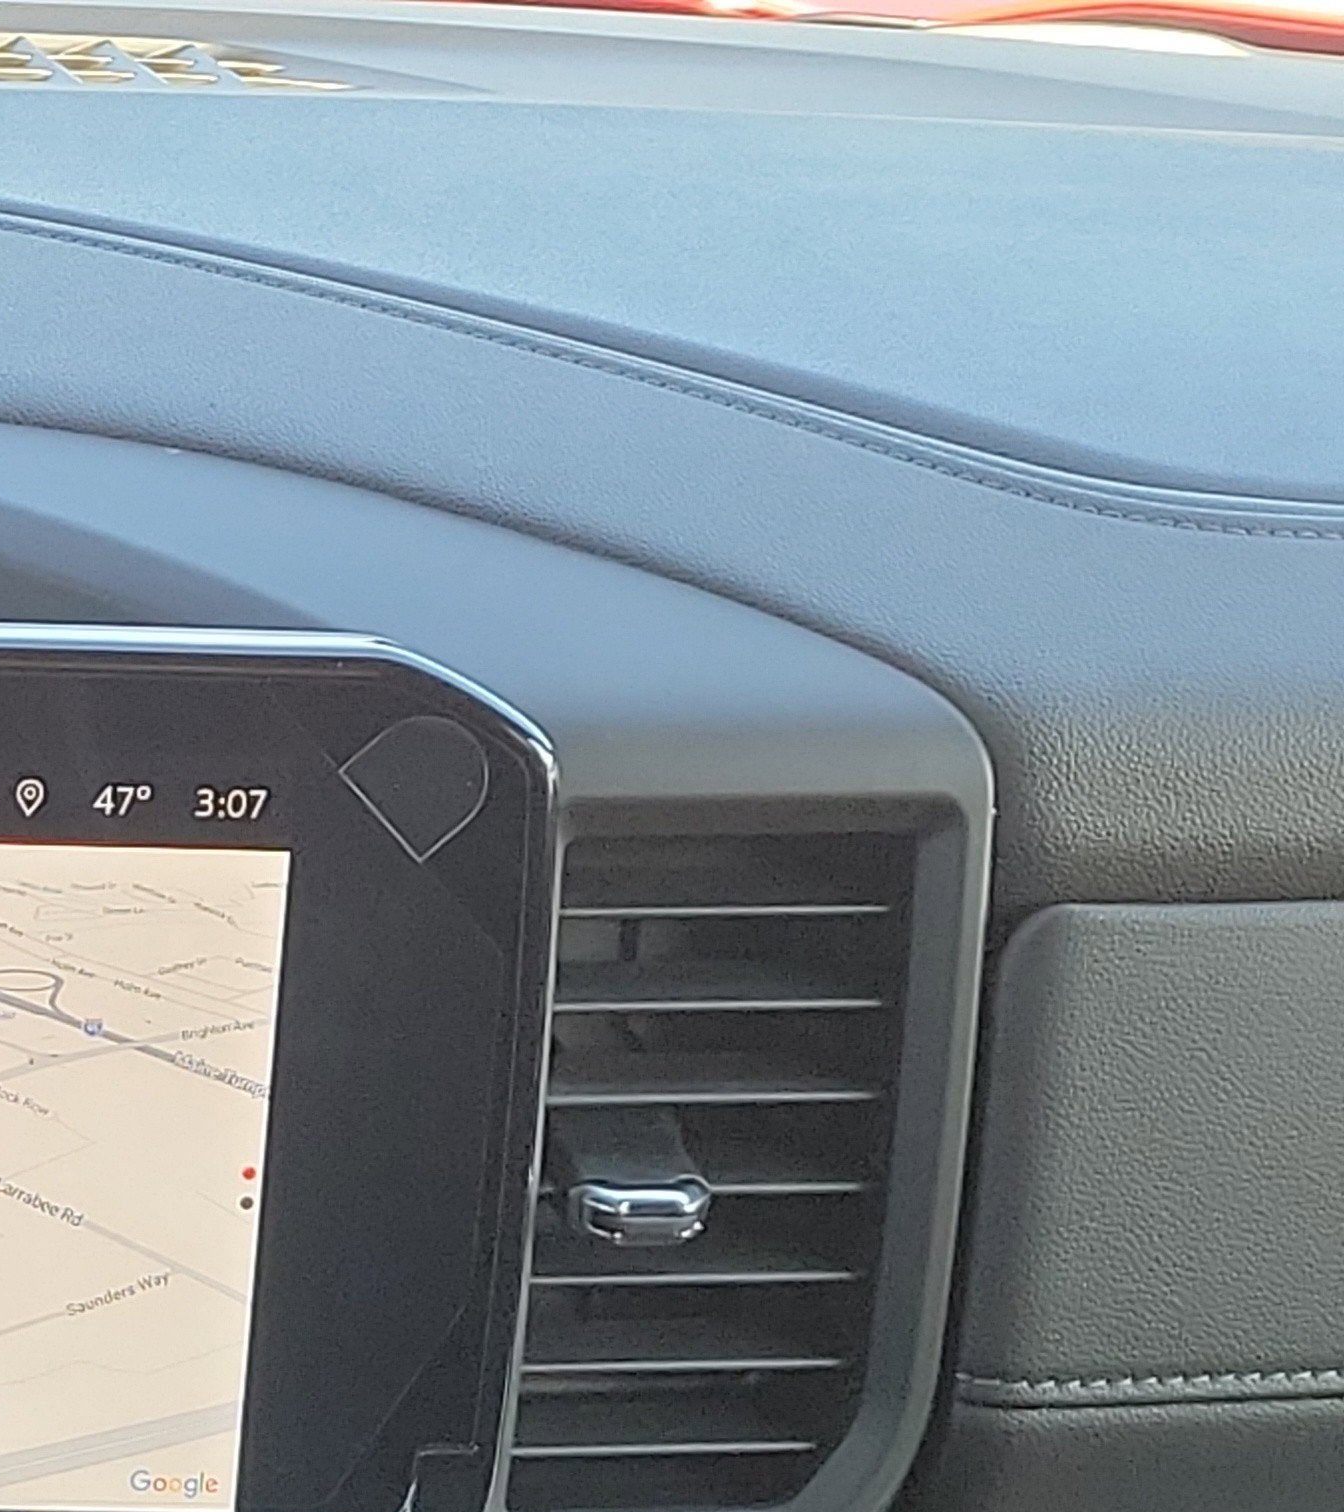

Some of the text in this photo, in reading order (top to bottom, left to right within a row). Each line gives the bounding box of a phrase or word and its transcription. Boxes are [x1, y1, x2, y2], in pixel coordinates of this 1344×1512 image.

[194, 788, 268, 819] 3:07
[58, 1206, 85, 1227] Rd
[66, 1271, 171, 1317] Saunders Way
[130, 1470, 220, 1498] Google
